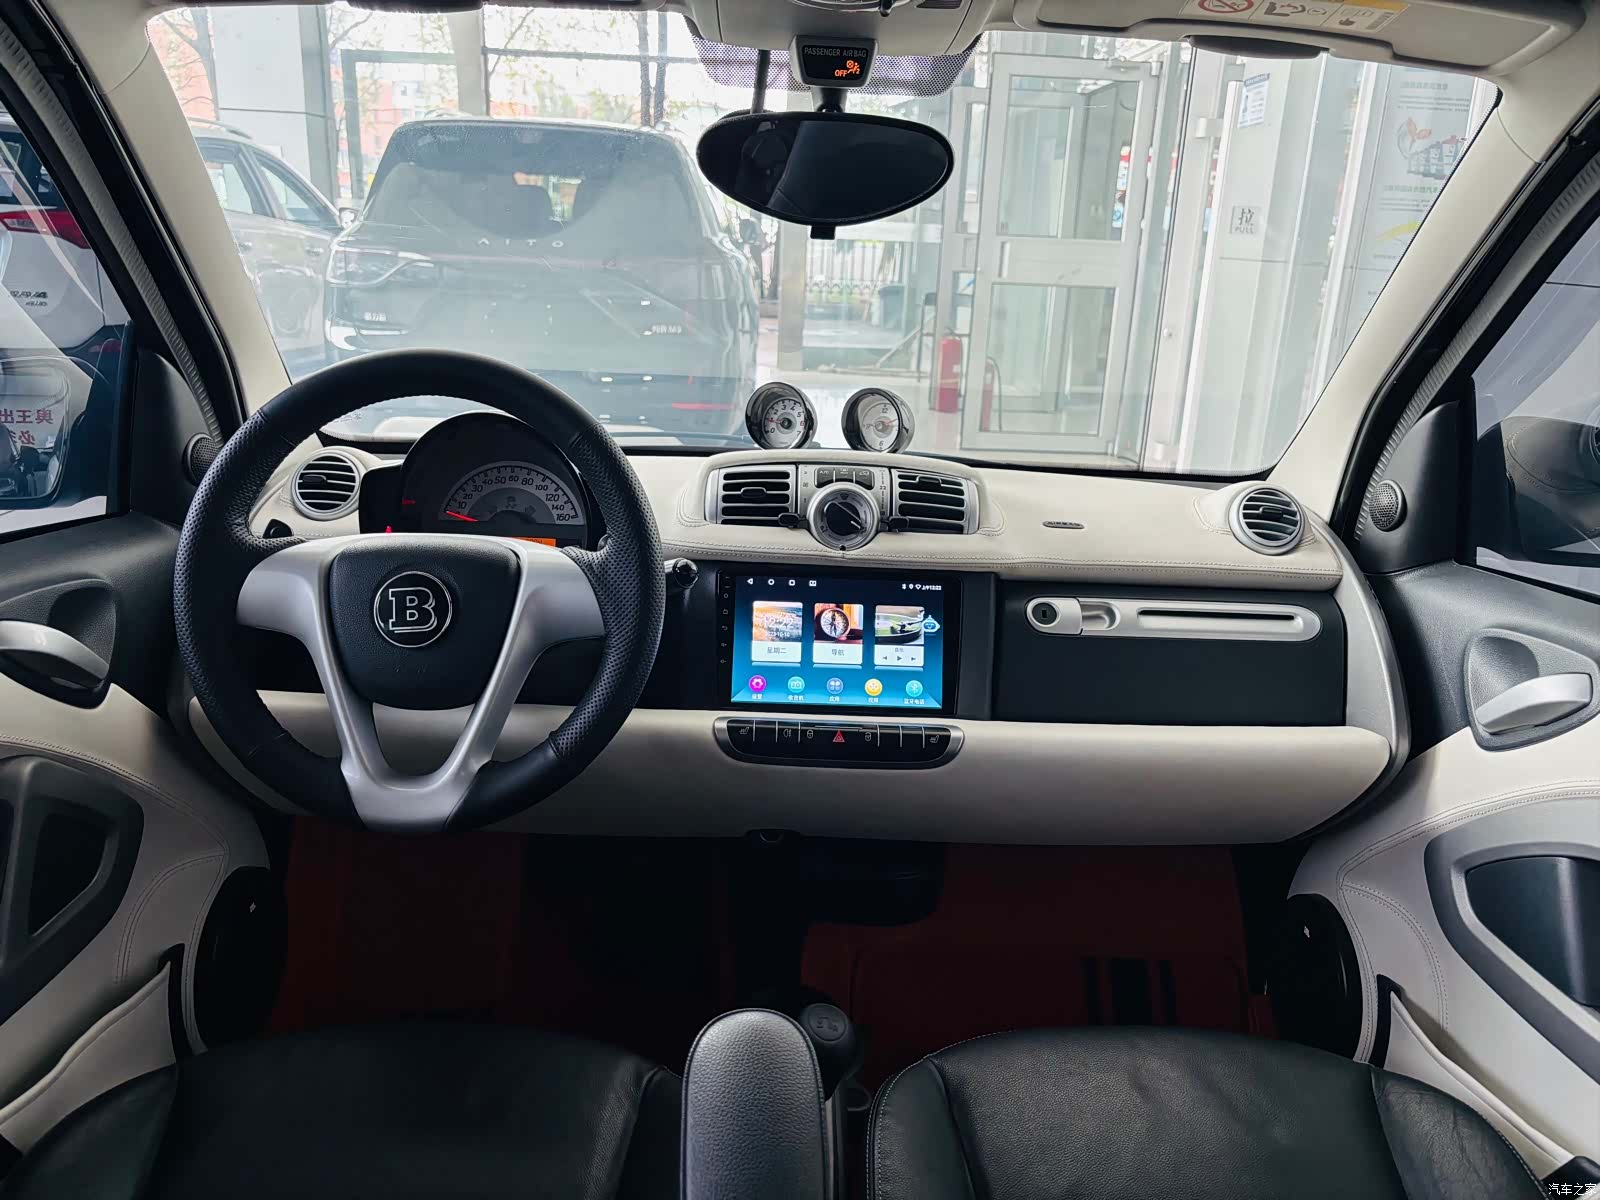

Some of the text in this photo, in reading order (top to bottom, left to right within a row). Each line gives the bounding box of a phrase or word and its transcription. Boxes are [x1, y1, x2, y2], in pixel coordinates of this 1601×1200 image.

[804, 47, 840, 56] PASSENGER
[834, 69, 847, 77] OFF
[1238, 208, 1255, 226] 拉
[479, 238, 564, 247] AITO
[389, 586, 437, 633] B
[763, 616, 794, 628] 12:22
[767, 646, 787, 654] 星期二
